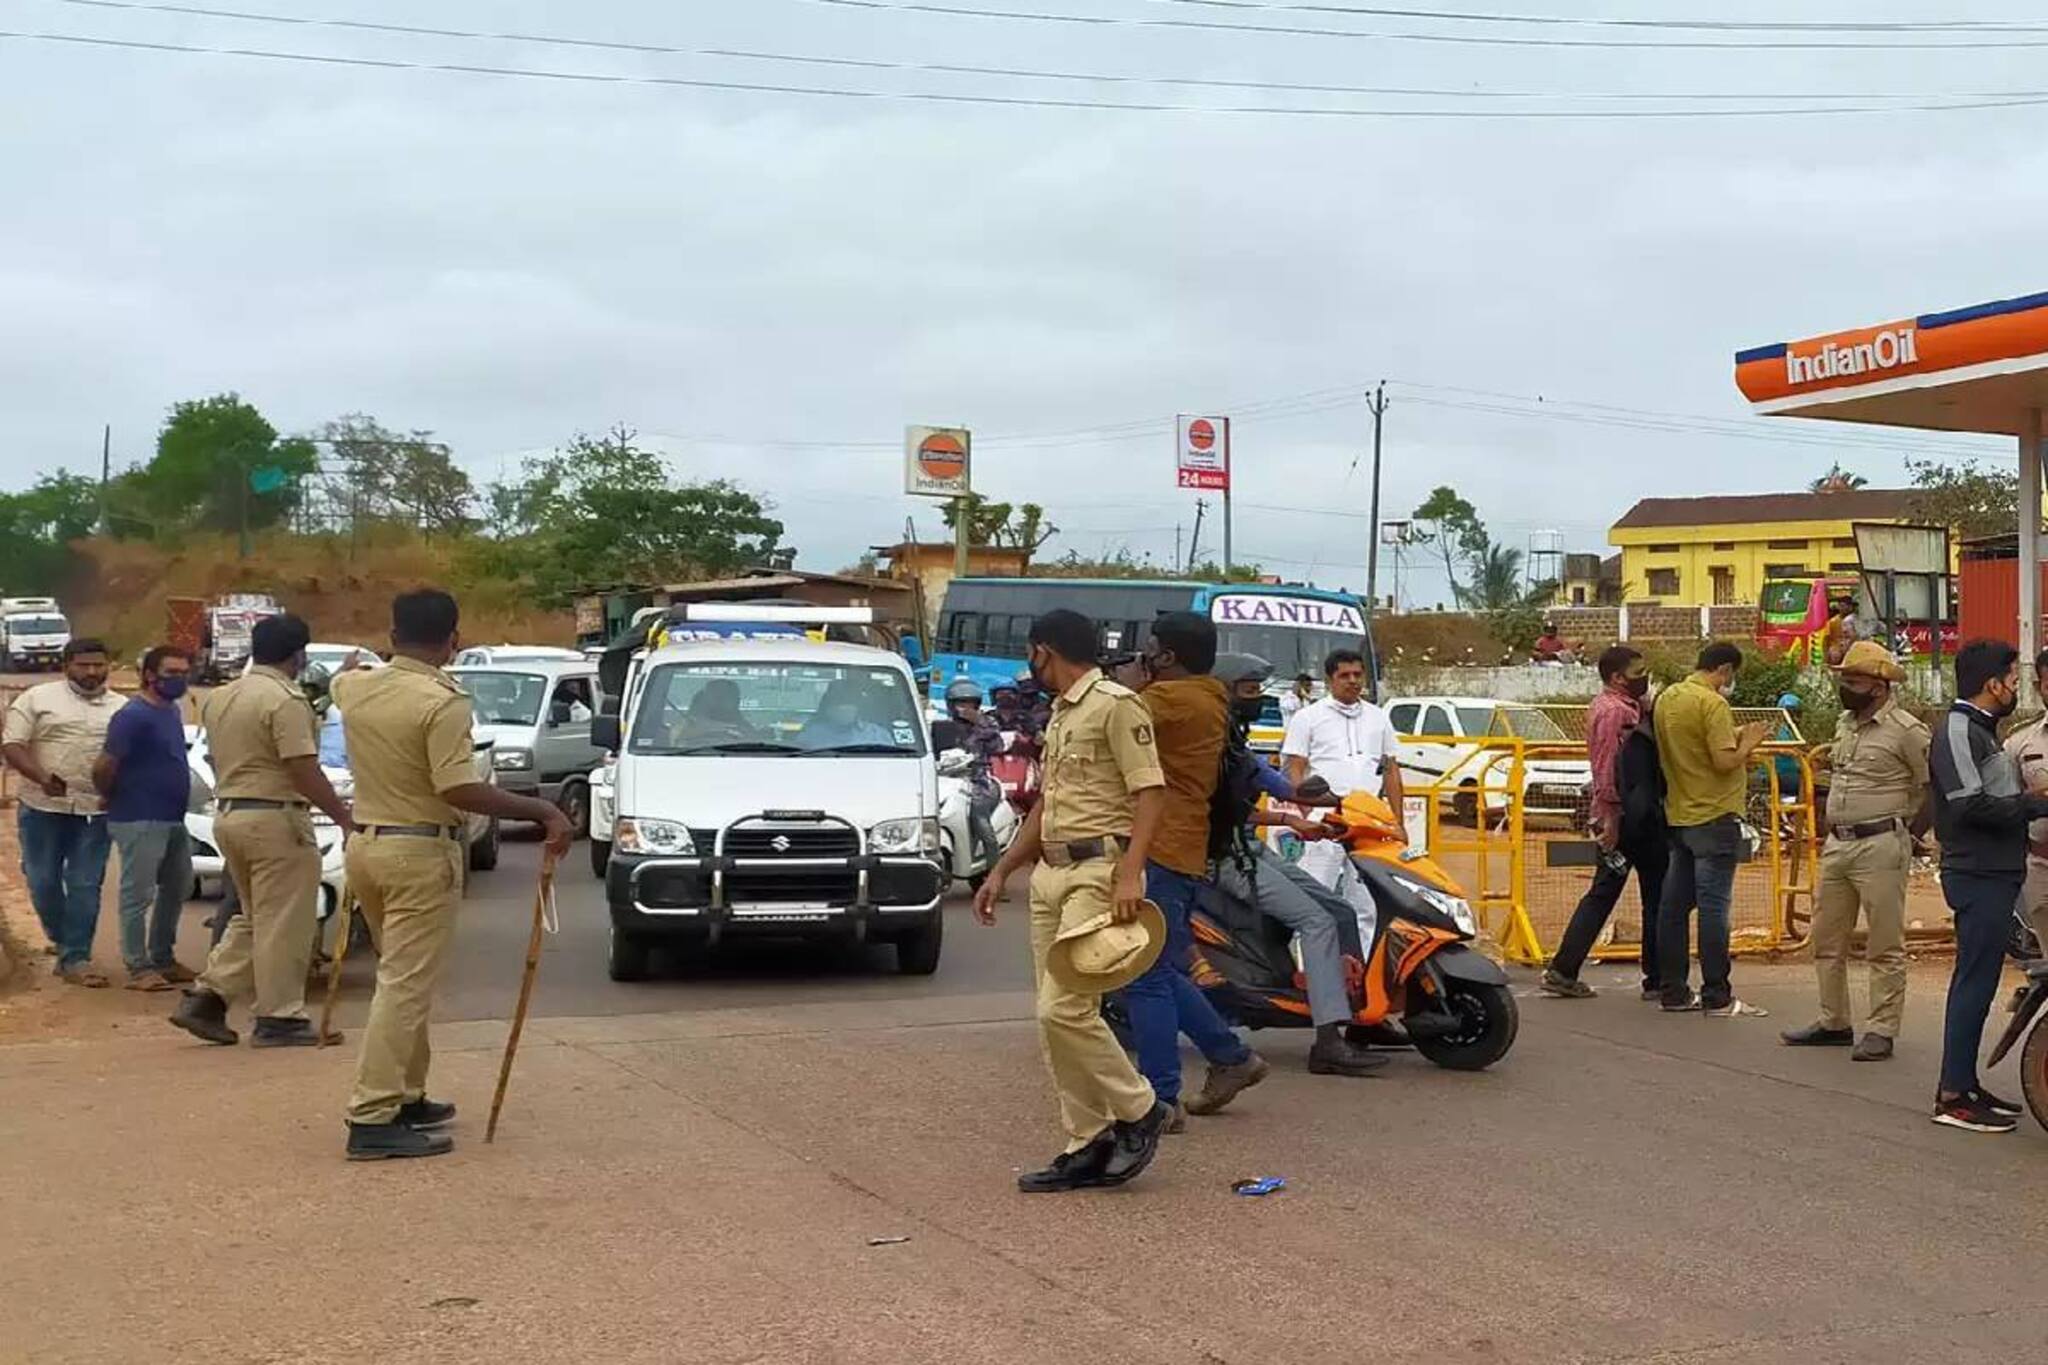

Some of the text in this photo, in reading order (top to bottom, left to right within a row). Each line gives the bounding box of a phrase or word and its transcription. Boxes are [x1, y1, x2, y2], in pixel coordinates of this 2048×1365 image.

[1787, 329, 1918, 384] IndianOil
[1181, 472, 1199, 486] 24
[1220, 599, 1359, 630] KANILA
